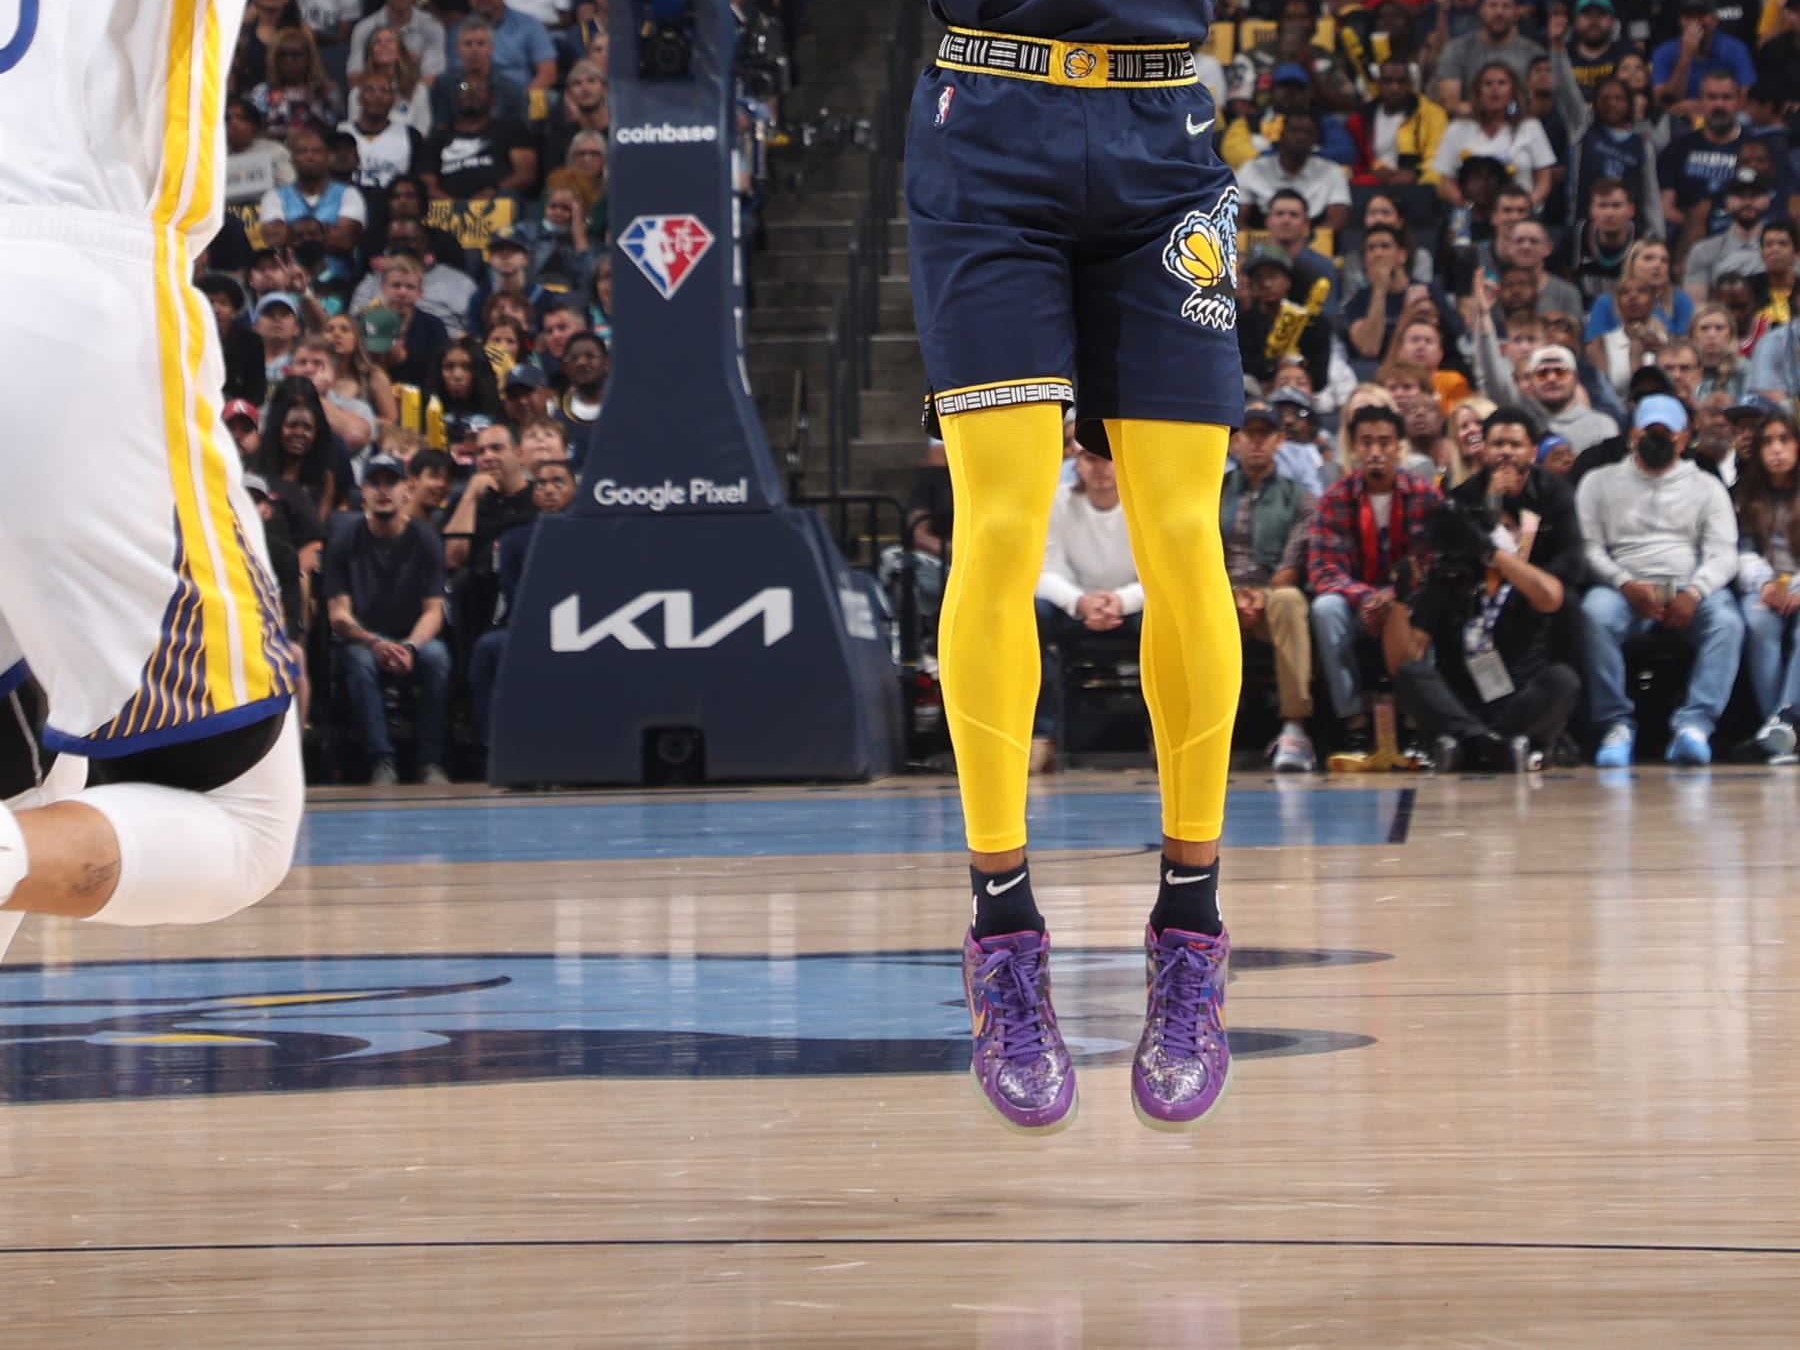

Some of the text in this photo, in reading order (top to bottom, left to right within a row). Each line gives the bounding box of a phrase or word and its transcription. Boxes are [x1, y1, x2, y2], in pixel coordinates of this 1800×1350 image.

[616, 122, 718, 144] coinbase
[593, 478, 747, 511] Google Pixel
